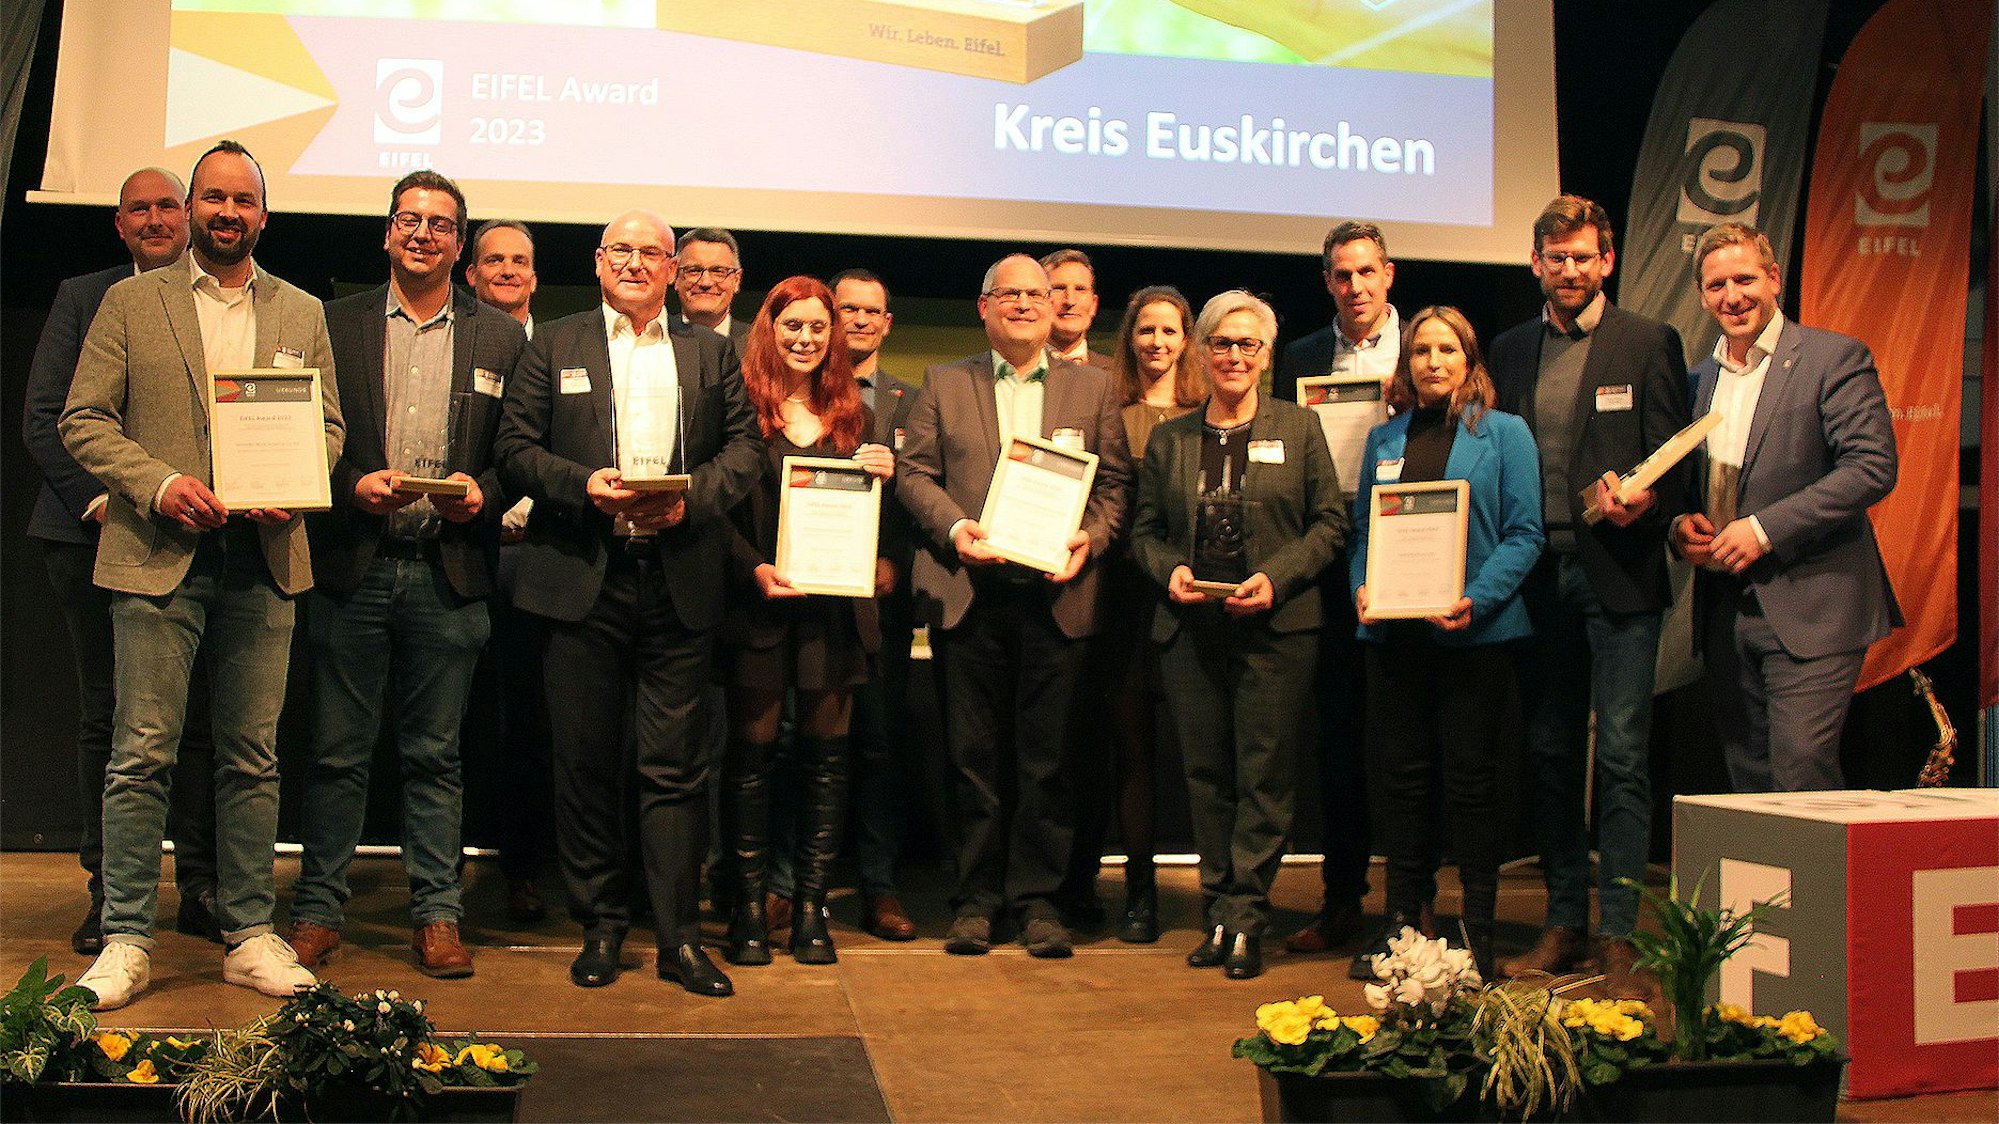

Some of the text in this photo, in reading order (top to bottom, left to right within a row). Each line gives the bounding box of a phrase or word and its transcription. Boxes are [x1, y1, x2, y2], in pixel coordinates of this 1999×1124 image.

[869, 23, 1006, 57] Wir. Leben. Eifel.
[471, 72, 660, 105] EIFEL Award
[468, 116, 547, 145] 2023
[993, 102, 1436, 176] Kreis Euskirchen
[378, 151, 434, 169] EIFEL
[1857, 236, 1921, 258] EIFEL
[632, 456, 668, 466] EIFEL
[1912, 864, 1999, 1047] E
